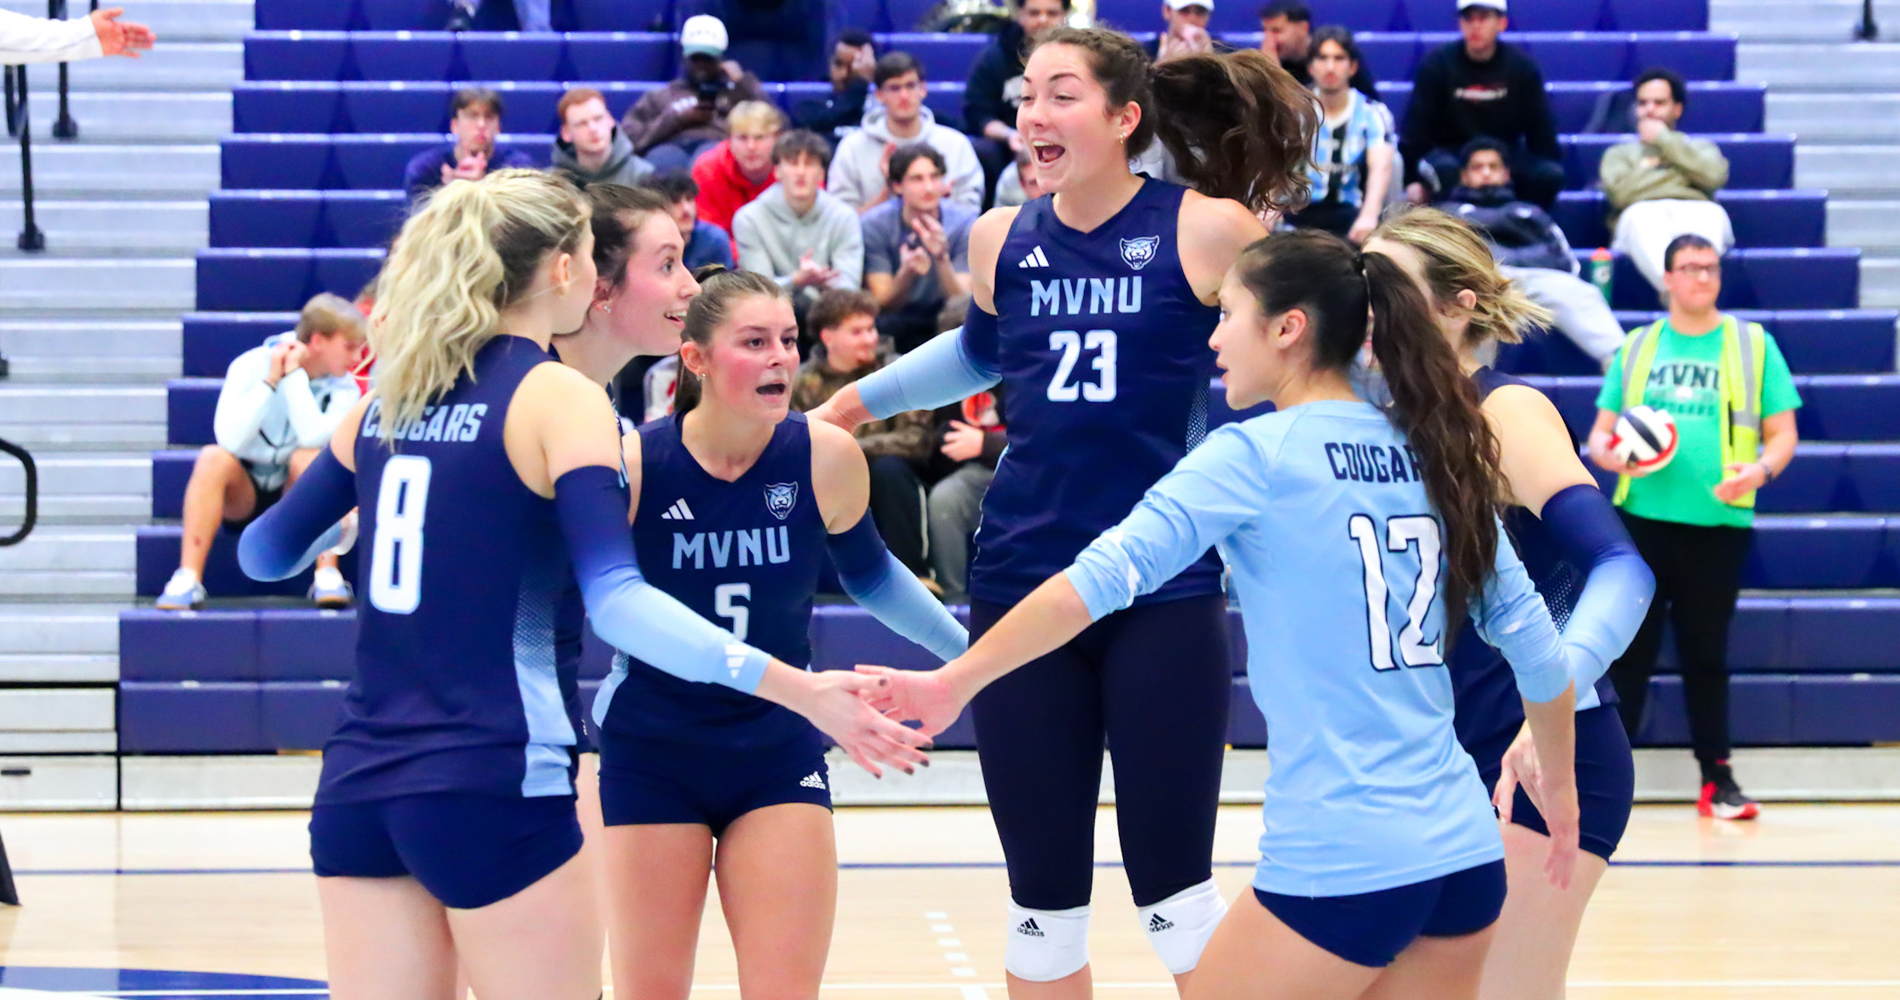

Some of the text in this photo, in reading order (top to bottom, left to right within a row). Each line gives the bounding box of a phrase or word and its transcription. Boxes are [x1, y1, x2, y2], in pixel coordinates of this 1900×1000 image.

[1030, 275, 1142, 316] MVNU
[1047, 329, 1118, 402] 23
[362, 398, 488, 442] CUGARS
[369, 454, 432, 615] 8
[672, 525, 790, 570] MVNU
[715, 582, 751, 642] 5
[1348, 512, 1445, 673] 12
